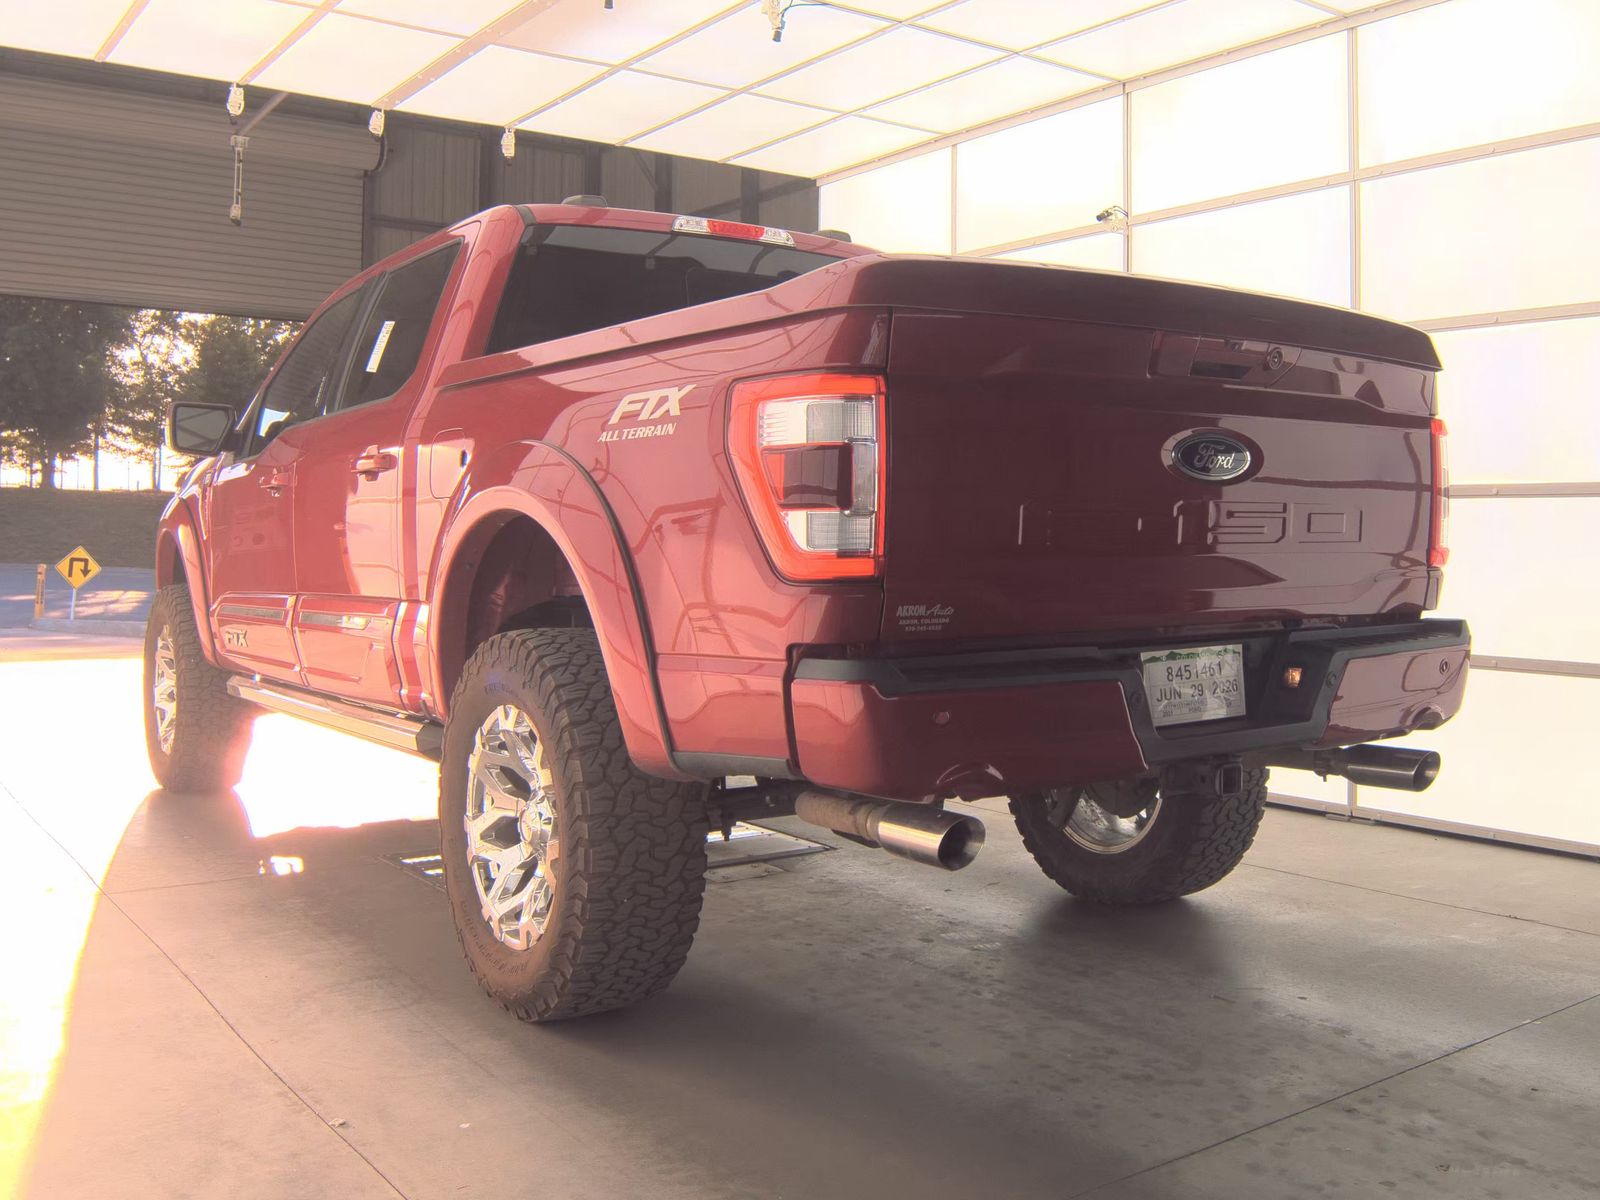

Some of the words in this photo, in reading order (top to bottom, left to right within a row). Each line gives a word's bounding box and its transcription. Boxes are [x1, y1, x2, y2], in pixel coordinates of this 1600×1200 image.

[607, 384, 697, 425] FTX
[597, 431, 620, 443] ALL
[621, 422, 677, 441] TERRAIN
[1193, 442, 1236, 469] Ford
[1156, 687, 1181, 702] JUN
[1191, 683, 1204, 698] 29
